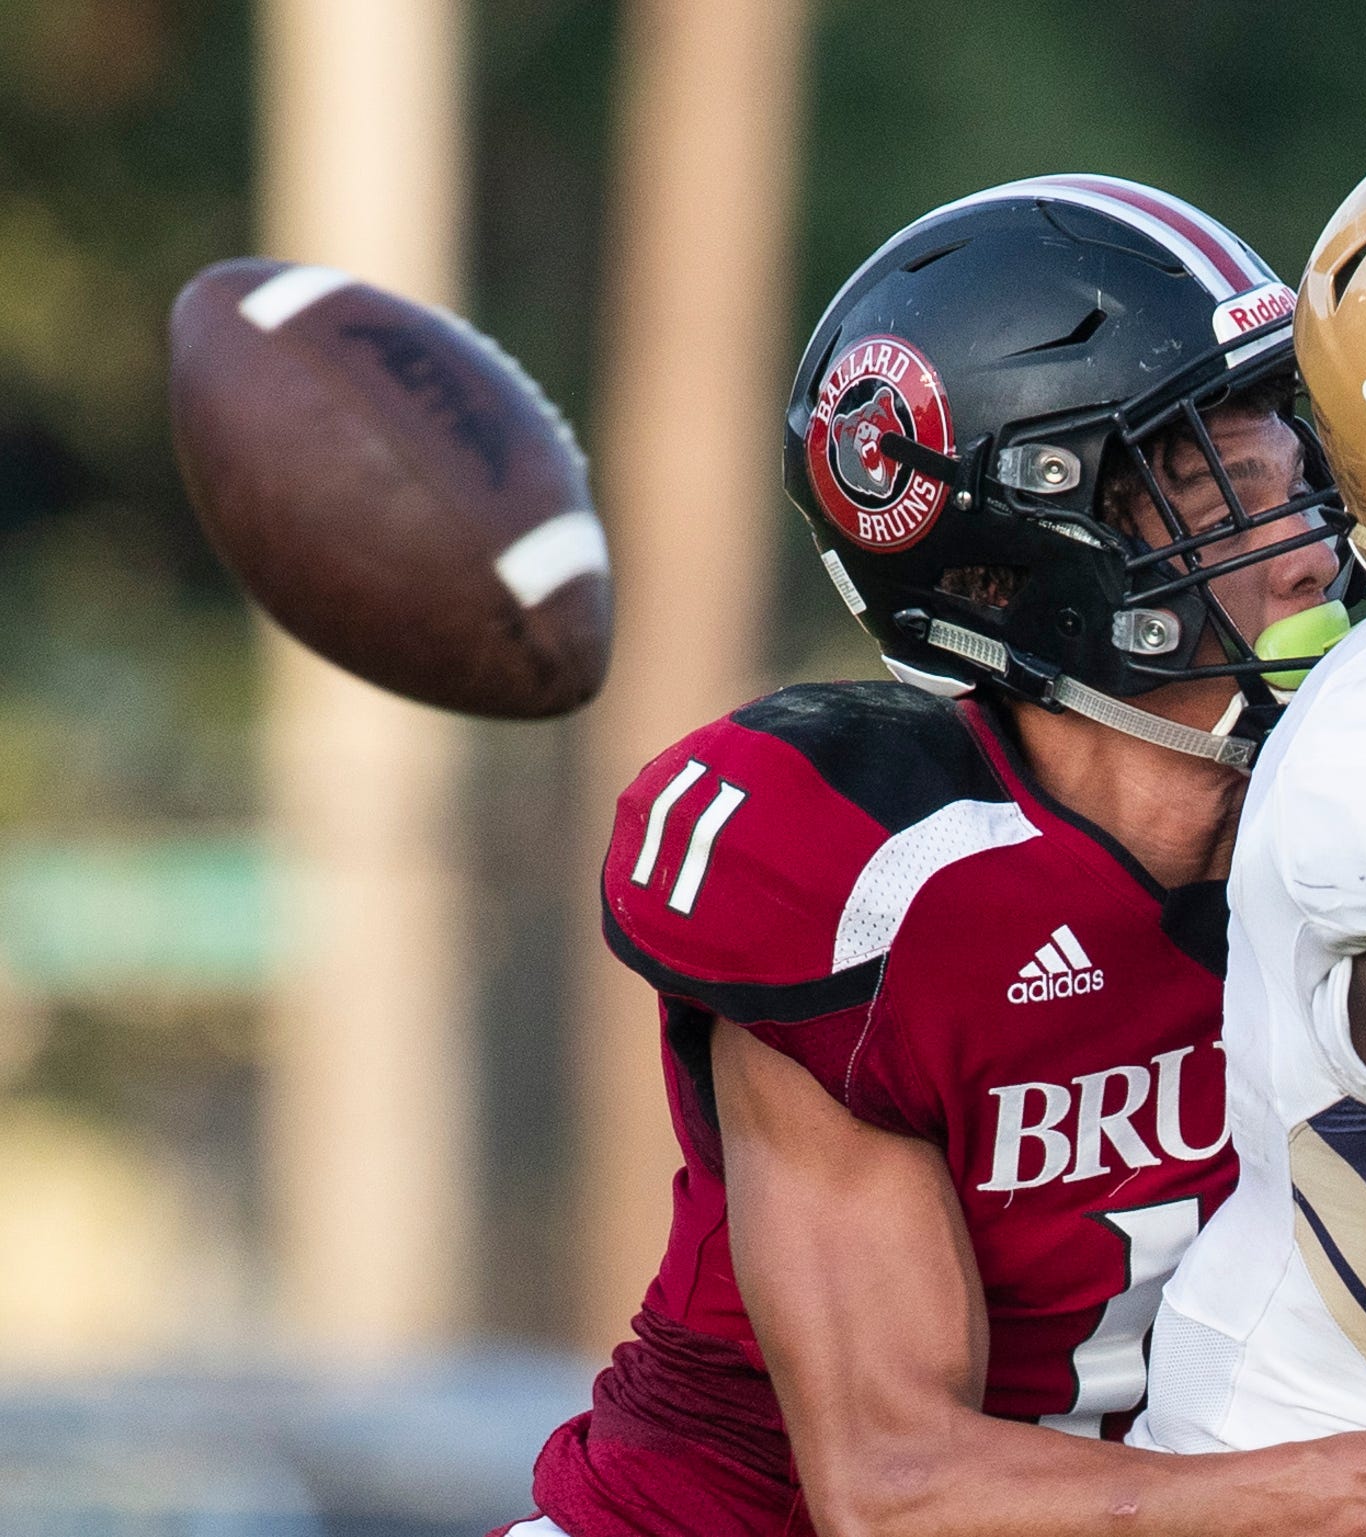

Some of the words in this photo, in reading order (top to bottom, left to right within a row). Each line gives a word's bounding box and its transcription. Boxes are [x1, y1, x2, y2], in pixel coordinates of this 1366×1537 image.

[816, 345, 910, 425] BALLARD
[857, 475, 936, 542] BRUINS
[630, 757, 750, 918] 11
[1006, 968, 1105, 1004] adidas
